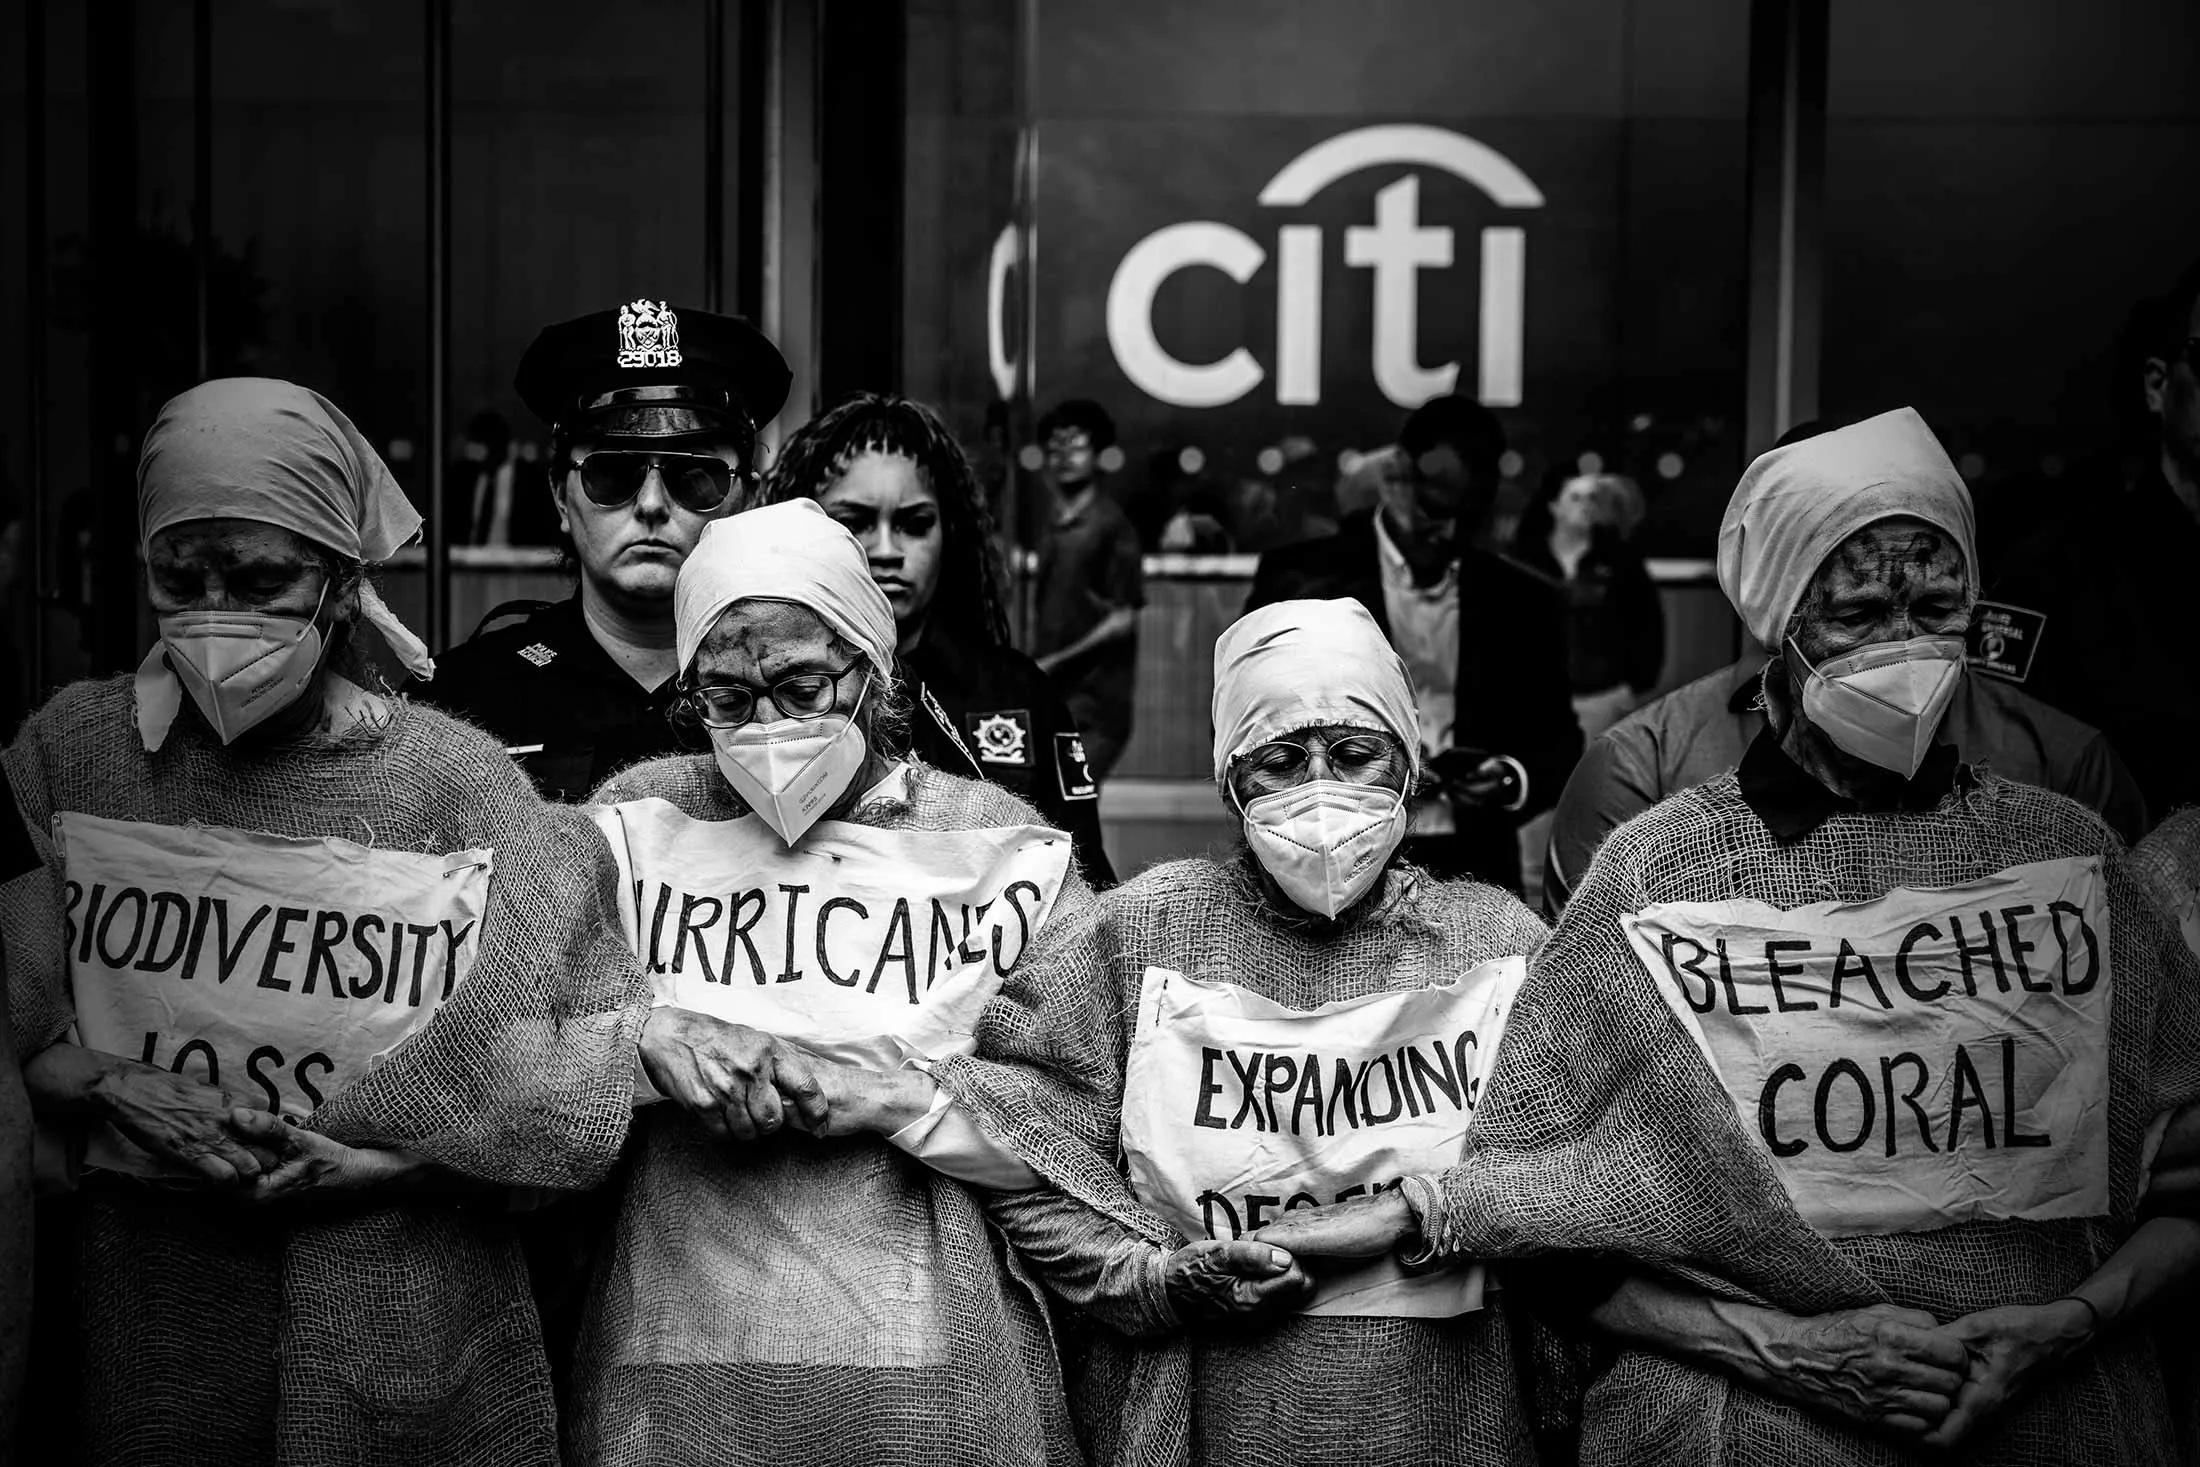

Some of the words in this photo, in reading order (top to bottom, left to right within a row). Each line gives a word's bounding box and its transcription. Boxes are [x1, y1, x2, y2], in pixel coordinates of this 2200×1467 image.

[1106, 173, 1527, 408] citi
[1661, 901, 2099, 1016] BLEACHED
[1193, 1030, 1479, 1137] EXPANDING
[1758, 1037, 2051, 1158] CORAL
